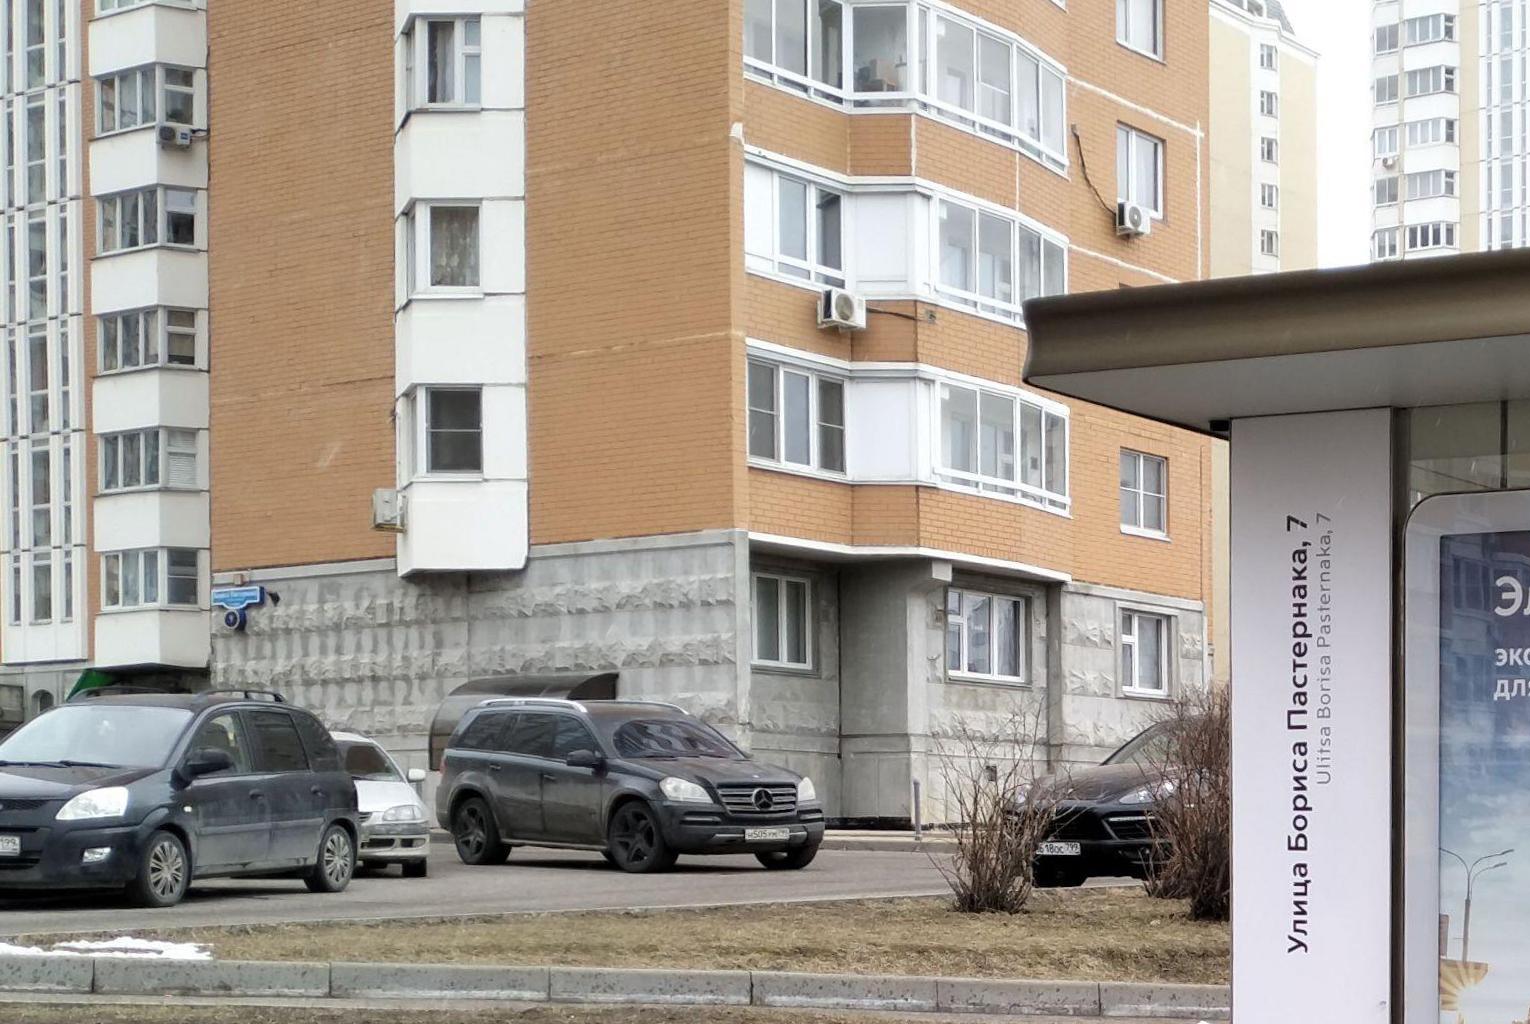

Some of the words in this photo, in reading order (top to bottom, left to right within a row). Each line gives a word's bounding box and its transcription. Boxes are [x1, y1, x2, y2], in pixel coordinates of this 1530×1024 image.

[1286, 514, 1309, 531] 7
[1316, 512, 1331, 524] 7
[1316, 530, 1333, 648] Pasternaka,
[1287, 542, 1313, 730] Пастернака,
[1316, 655, 1332, 719] Borisa
[1316, 727, 1332, 785] Ulitsa
[1287, 742, 1313, 851] Бориса
[1287, 862, 1311, 953] Улица
